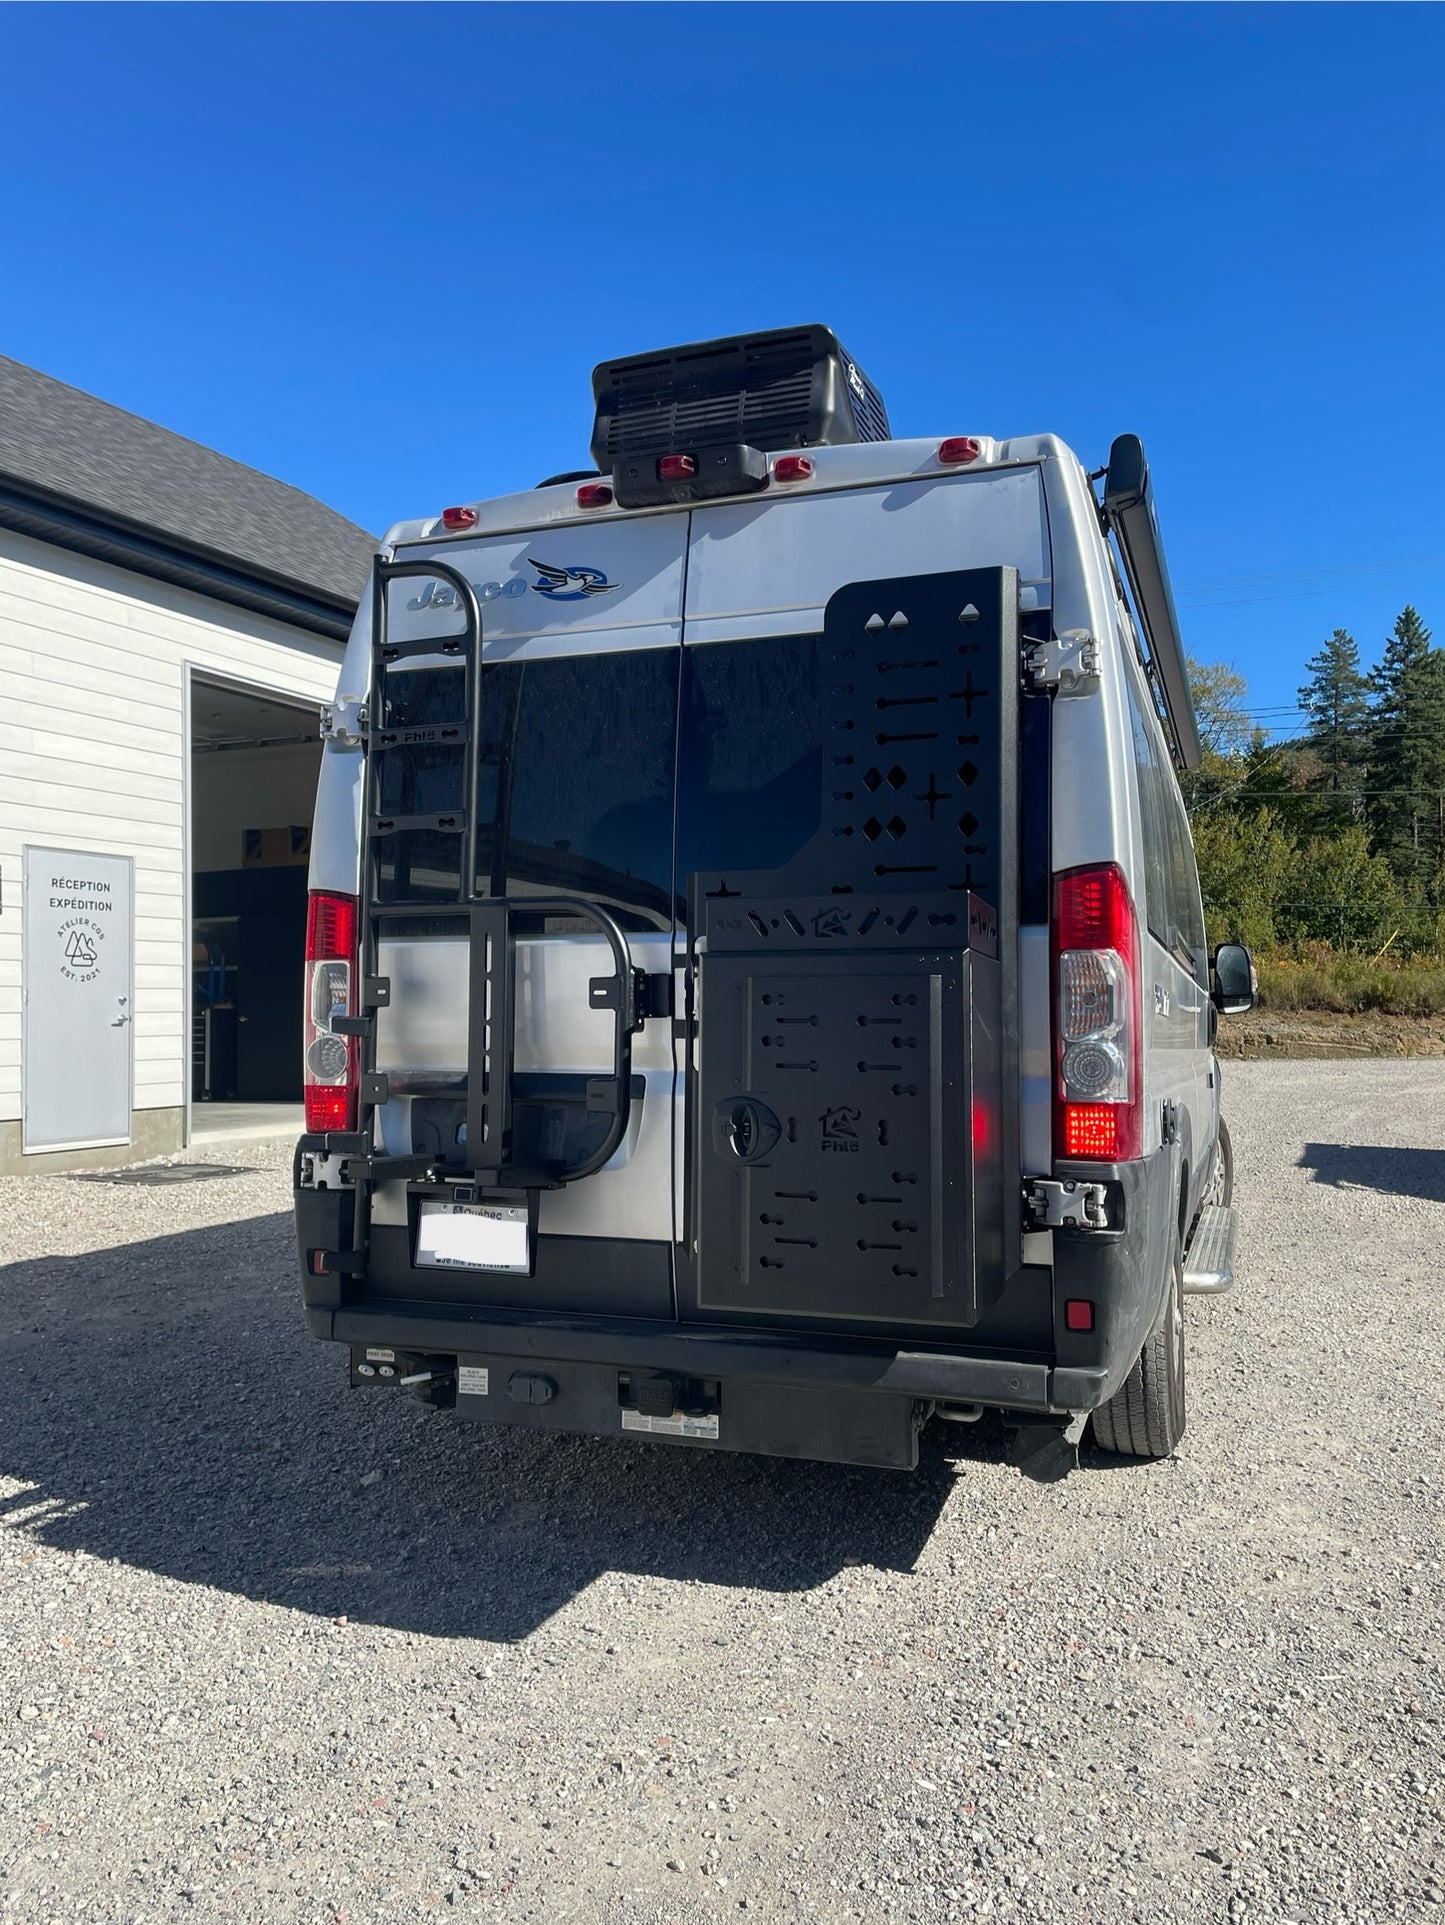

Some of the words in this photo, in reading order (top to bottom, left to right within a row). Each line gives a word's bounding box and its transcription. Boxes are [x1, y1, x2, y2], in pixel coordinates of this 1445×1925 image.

[406, 578, 528, 611] Jaco
[51, 876, 111, 892] RÉCEPTION
[49, 897, 112, 912] EXPÉDITION
[57, 917, 90, 938] ATELIER
[60, 966, 77, 982] EST.
[80, 968, 101, 983] 2021
